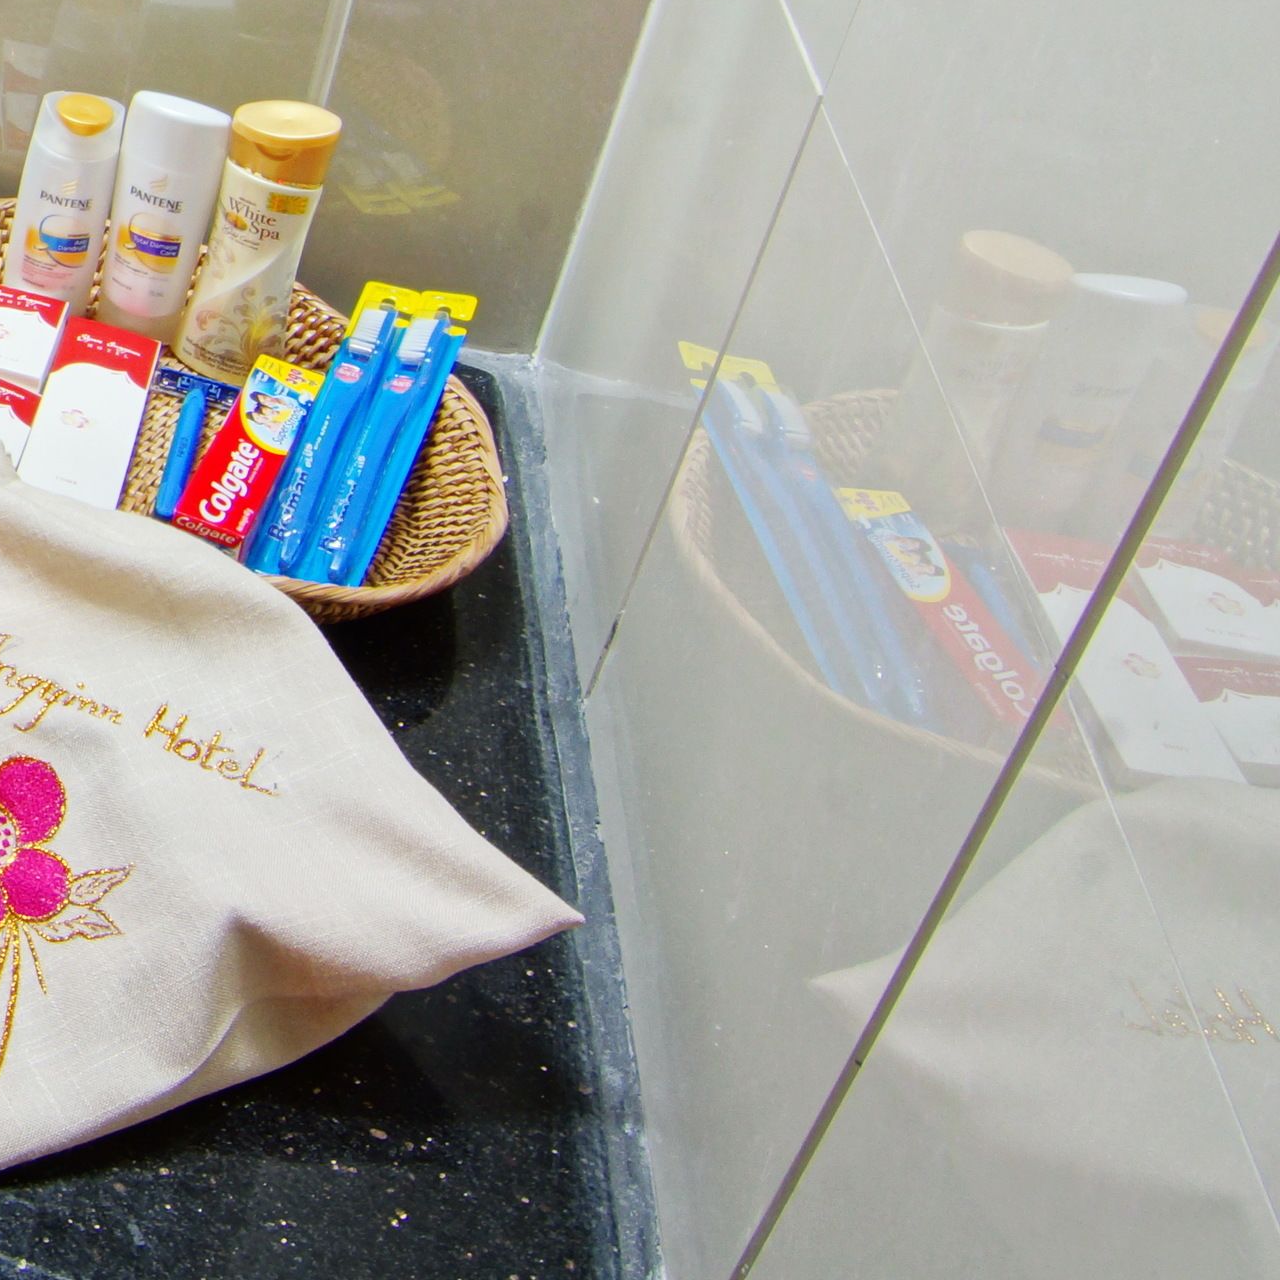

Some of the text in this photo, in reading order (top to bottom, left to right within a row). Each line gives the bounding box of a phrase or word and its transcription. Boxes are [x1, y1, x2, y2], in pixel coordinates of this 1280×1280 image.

[40, 190, 92, 209] PANTENE
[130, 186, 183, 210] PANTENE
[229, 196, 277, 226] White
[249, 221, 280, 240] Spa
[199, 439, 260, 524] Colgate
[175, 515, 237, 545] Colgate
[143, 702, 279, 797] Hotel
